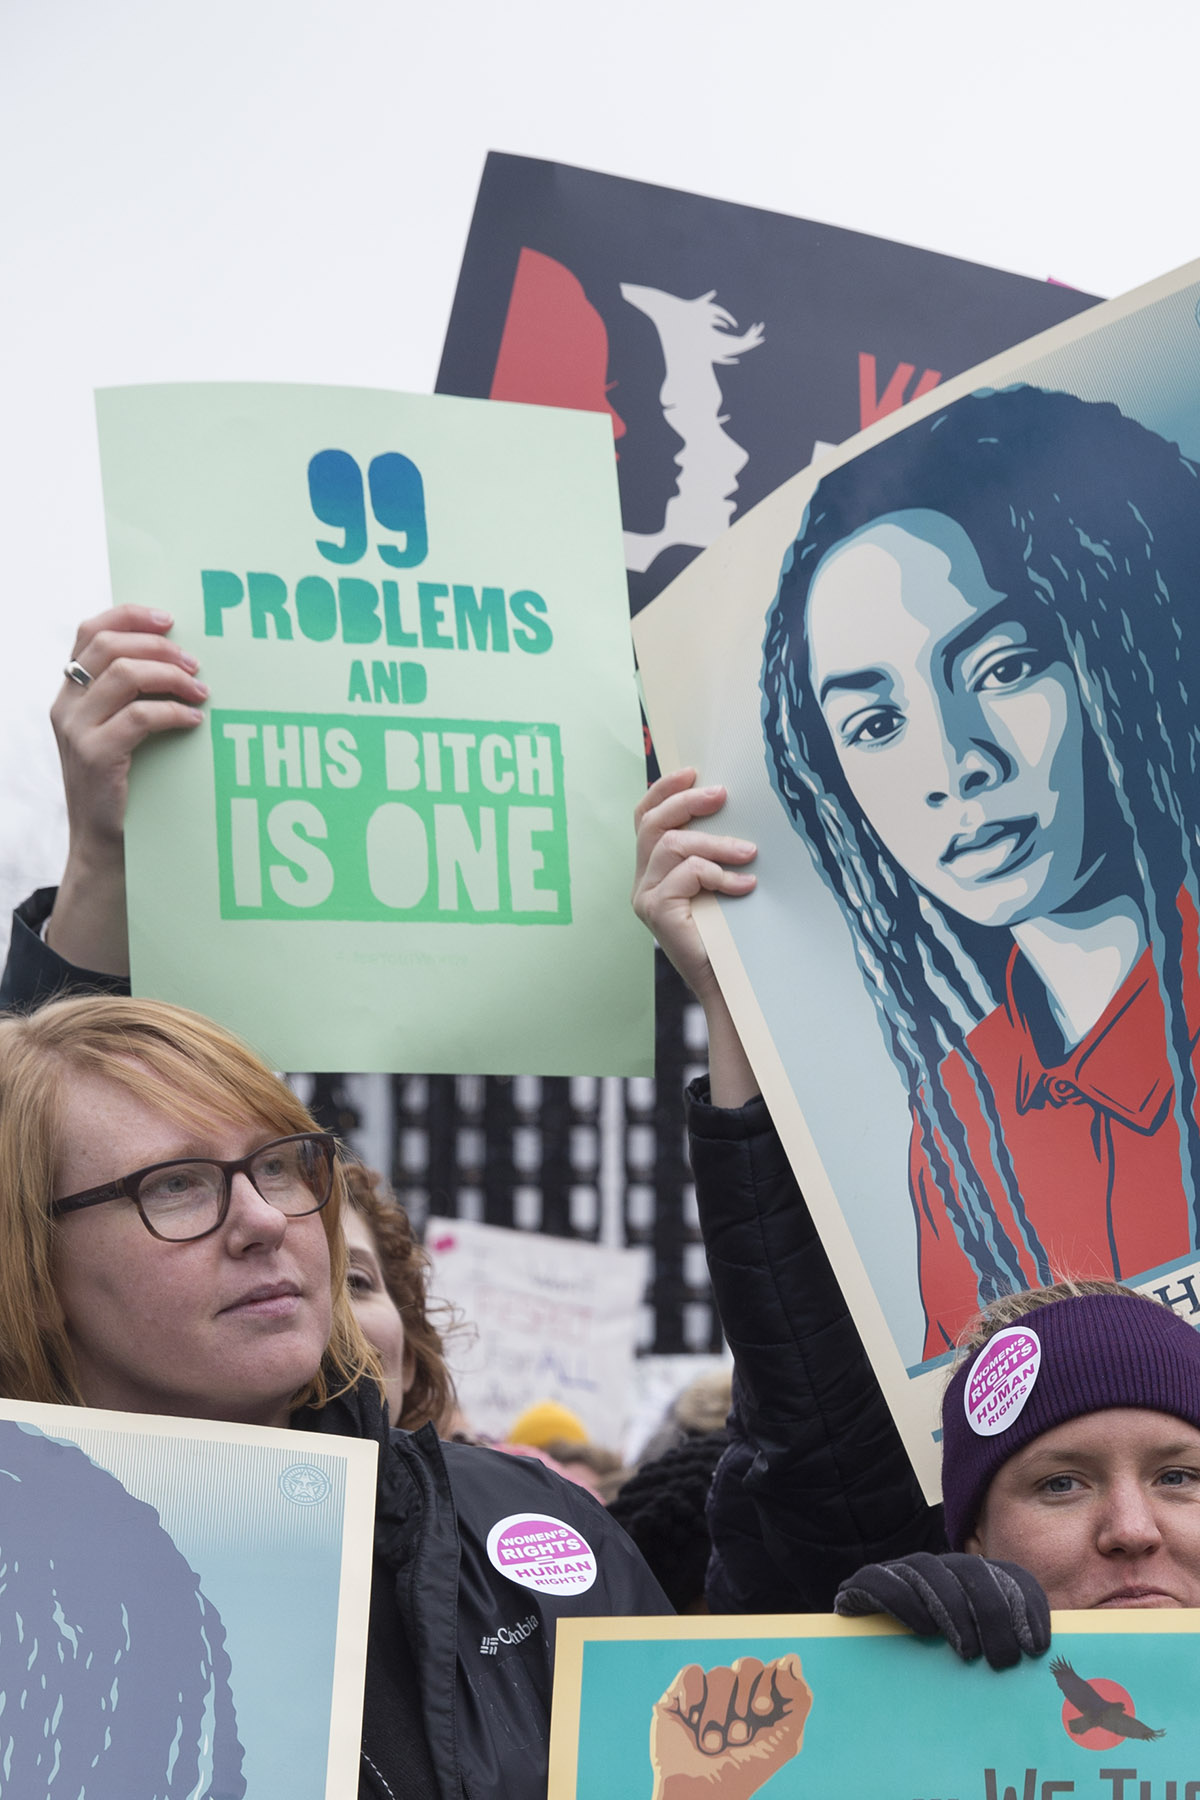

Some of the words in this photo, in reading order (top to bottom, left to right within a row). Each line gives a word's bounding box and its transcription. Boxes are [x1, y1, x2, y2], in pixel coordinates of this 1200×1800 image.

[308, 448, 428, 568] 99
[200, 569, 554, 654] PROBLEMS
[348, 659, 427, 704] AND
[223, 723, 361, 788] THIS
[384, 728, 554, 796] BITCH
[231, 798, 336, 908] IS
[365, 801, 558, 912] ONE
[971, 1343, 1032, 1403] RIGHTS
[972, 1337, 1026, 1385] WOMEN'S
[976, 1363, 1034, 1424] HUMAN
[987, 1384, 1027, 1426] RIGHTS
[500, 1529, 568, 1546] WOMEN'S
[500, 1538, 581, 1560] RIGHTS
[514, 1561, 592, 1578] HUMAN
[535, 1575, 587, 1586] RIGHTS
